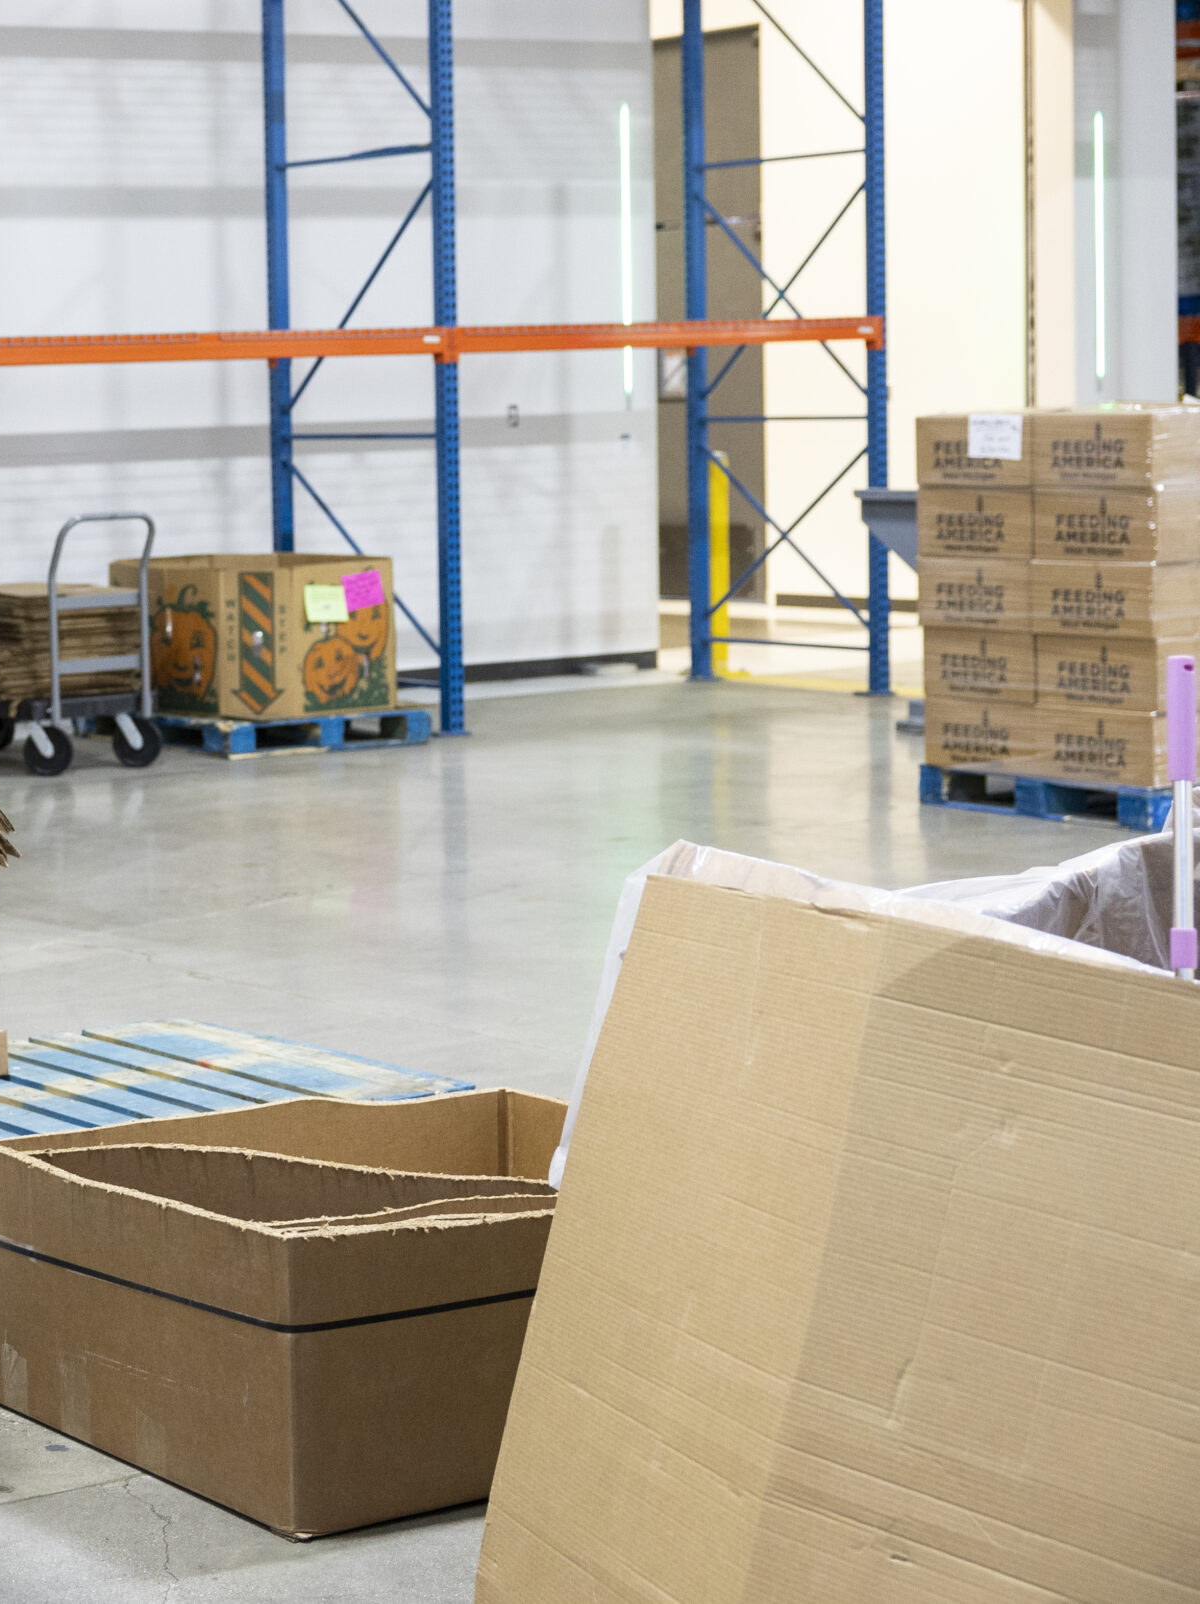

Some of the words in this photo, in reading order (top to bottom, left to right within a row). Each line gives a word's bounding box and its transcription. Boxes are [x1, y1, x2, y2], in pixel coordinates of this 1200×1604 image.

[1051, 438, 1125, 454] FEEDING
[1051, 456, 1125, 469] AMERICA
[936, 513, 1005, 527] FEEDING
[1056, 514, 1129, 529] FEEDING
[936, 528, 1005, 542] AMERICA
[1055, 530, 1130, 545] AMERICA
[936, 583, 1004, 598] FEEDING
[1051, 588, 1125, 604] FEEDING
[936, 600, 1004, 613] AMERICA
[1051, 604, 1125, 619] AMERICA
[940, 653, 1007, 670] FEEDING
[941, 669, 1007, 683] AMERICA
[1057, 661, 1130, 679] FEEDING
[1057, 677, 1131, 693] AMERICA
[943, 723, 1010, 741] FEEDING
[1054, 733, 1127, 752] FEEDING
[1053, 750, 1127, 768] AMERICA
